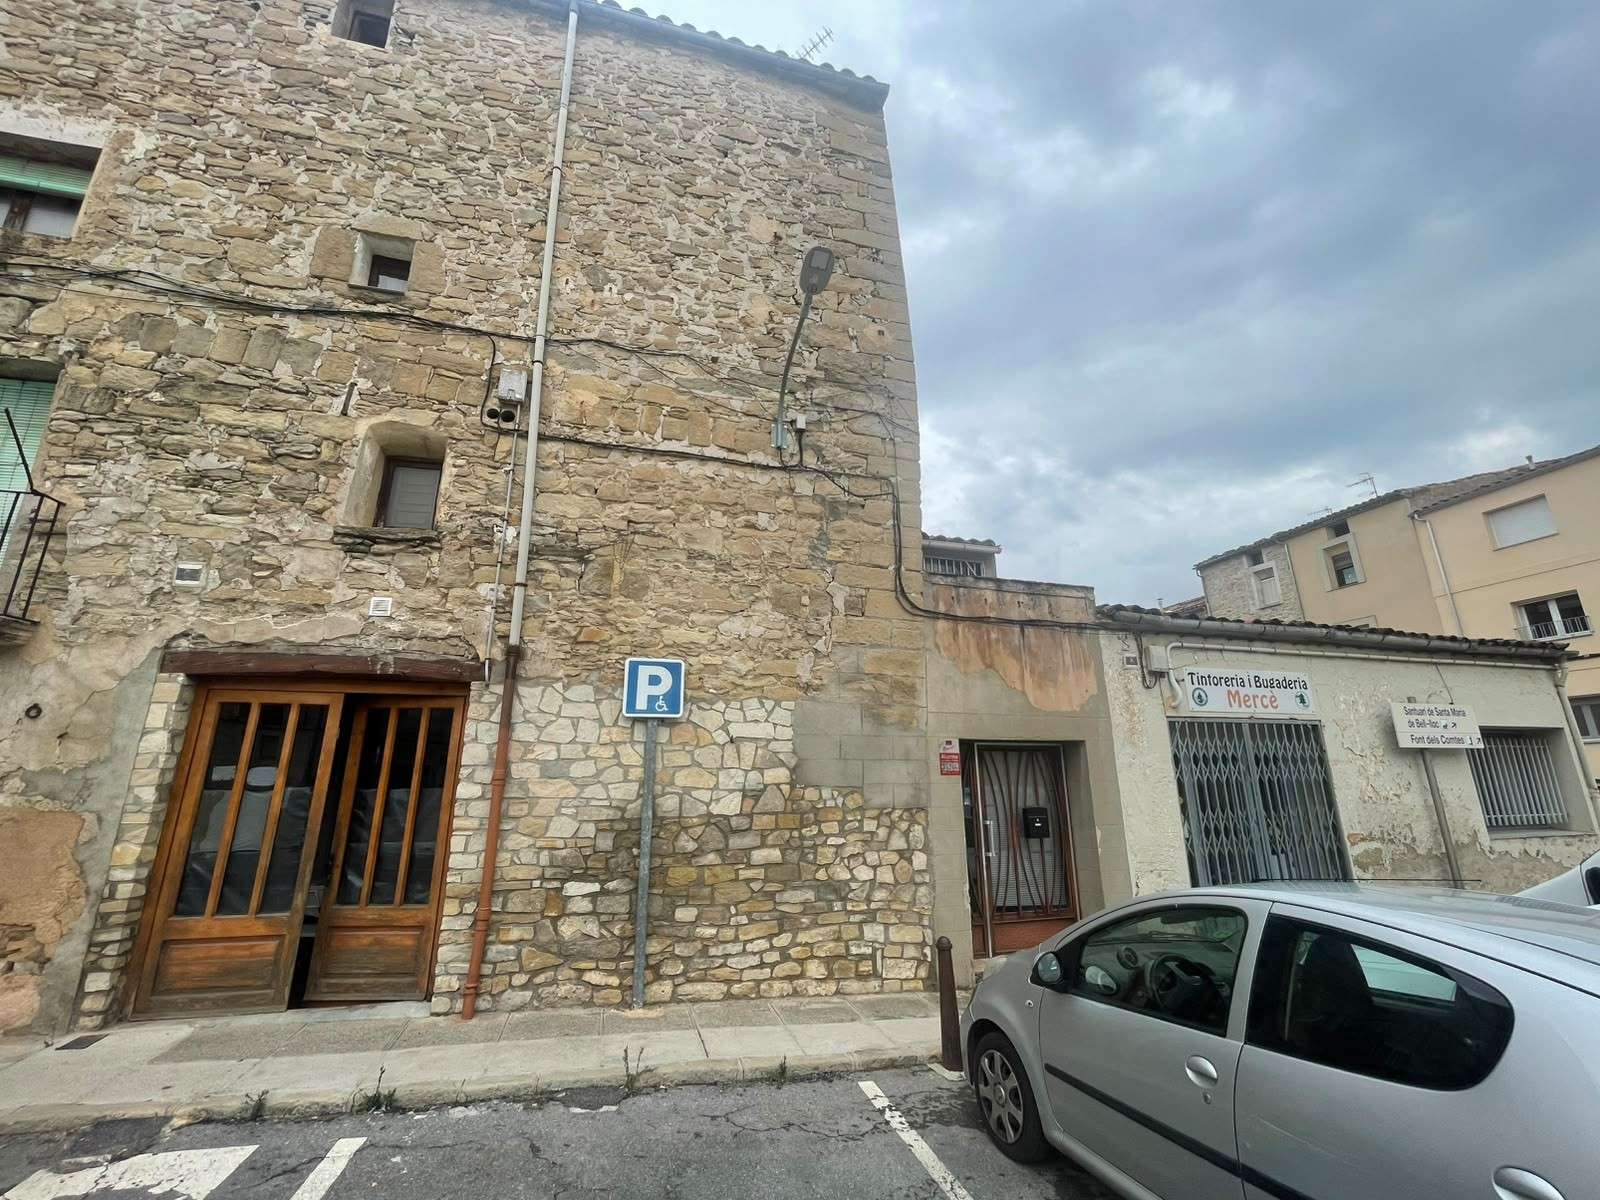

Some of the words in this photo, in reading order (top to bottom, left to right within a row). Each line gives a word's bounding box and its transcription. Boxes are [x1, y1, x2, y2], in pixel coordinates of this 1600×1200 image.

[635, 665, 673, 710] P
[1187, 672, 1246, 688] Tintoreria
[1247, 674, 1251, 688] i
[1253, 675, 1308, 690] Bugaderia
[1226, 689, 1279, 709] Mercè
[1403, 706, 1426, 717] Santuari
[1427, 706, 1435, 717] de
[1435, 707, 1450, 717] Santa
[1450, 708, 1466, 717] Maria
[1408, 719, 1415, 728] de
[1410, 734, 1425, 744] Font
[1426, 735, 1440, 745] dels
[1440, 735, 1465, 745] Comtes
